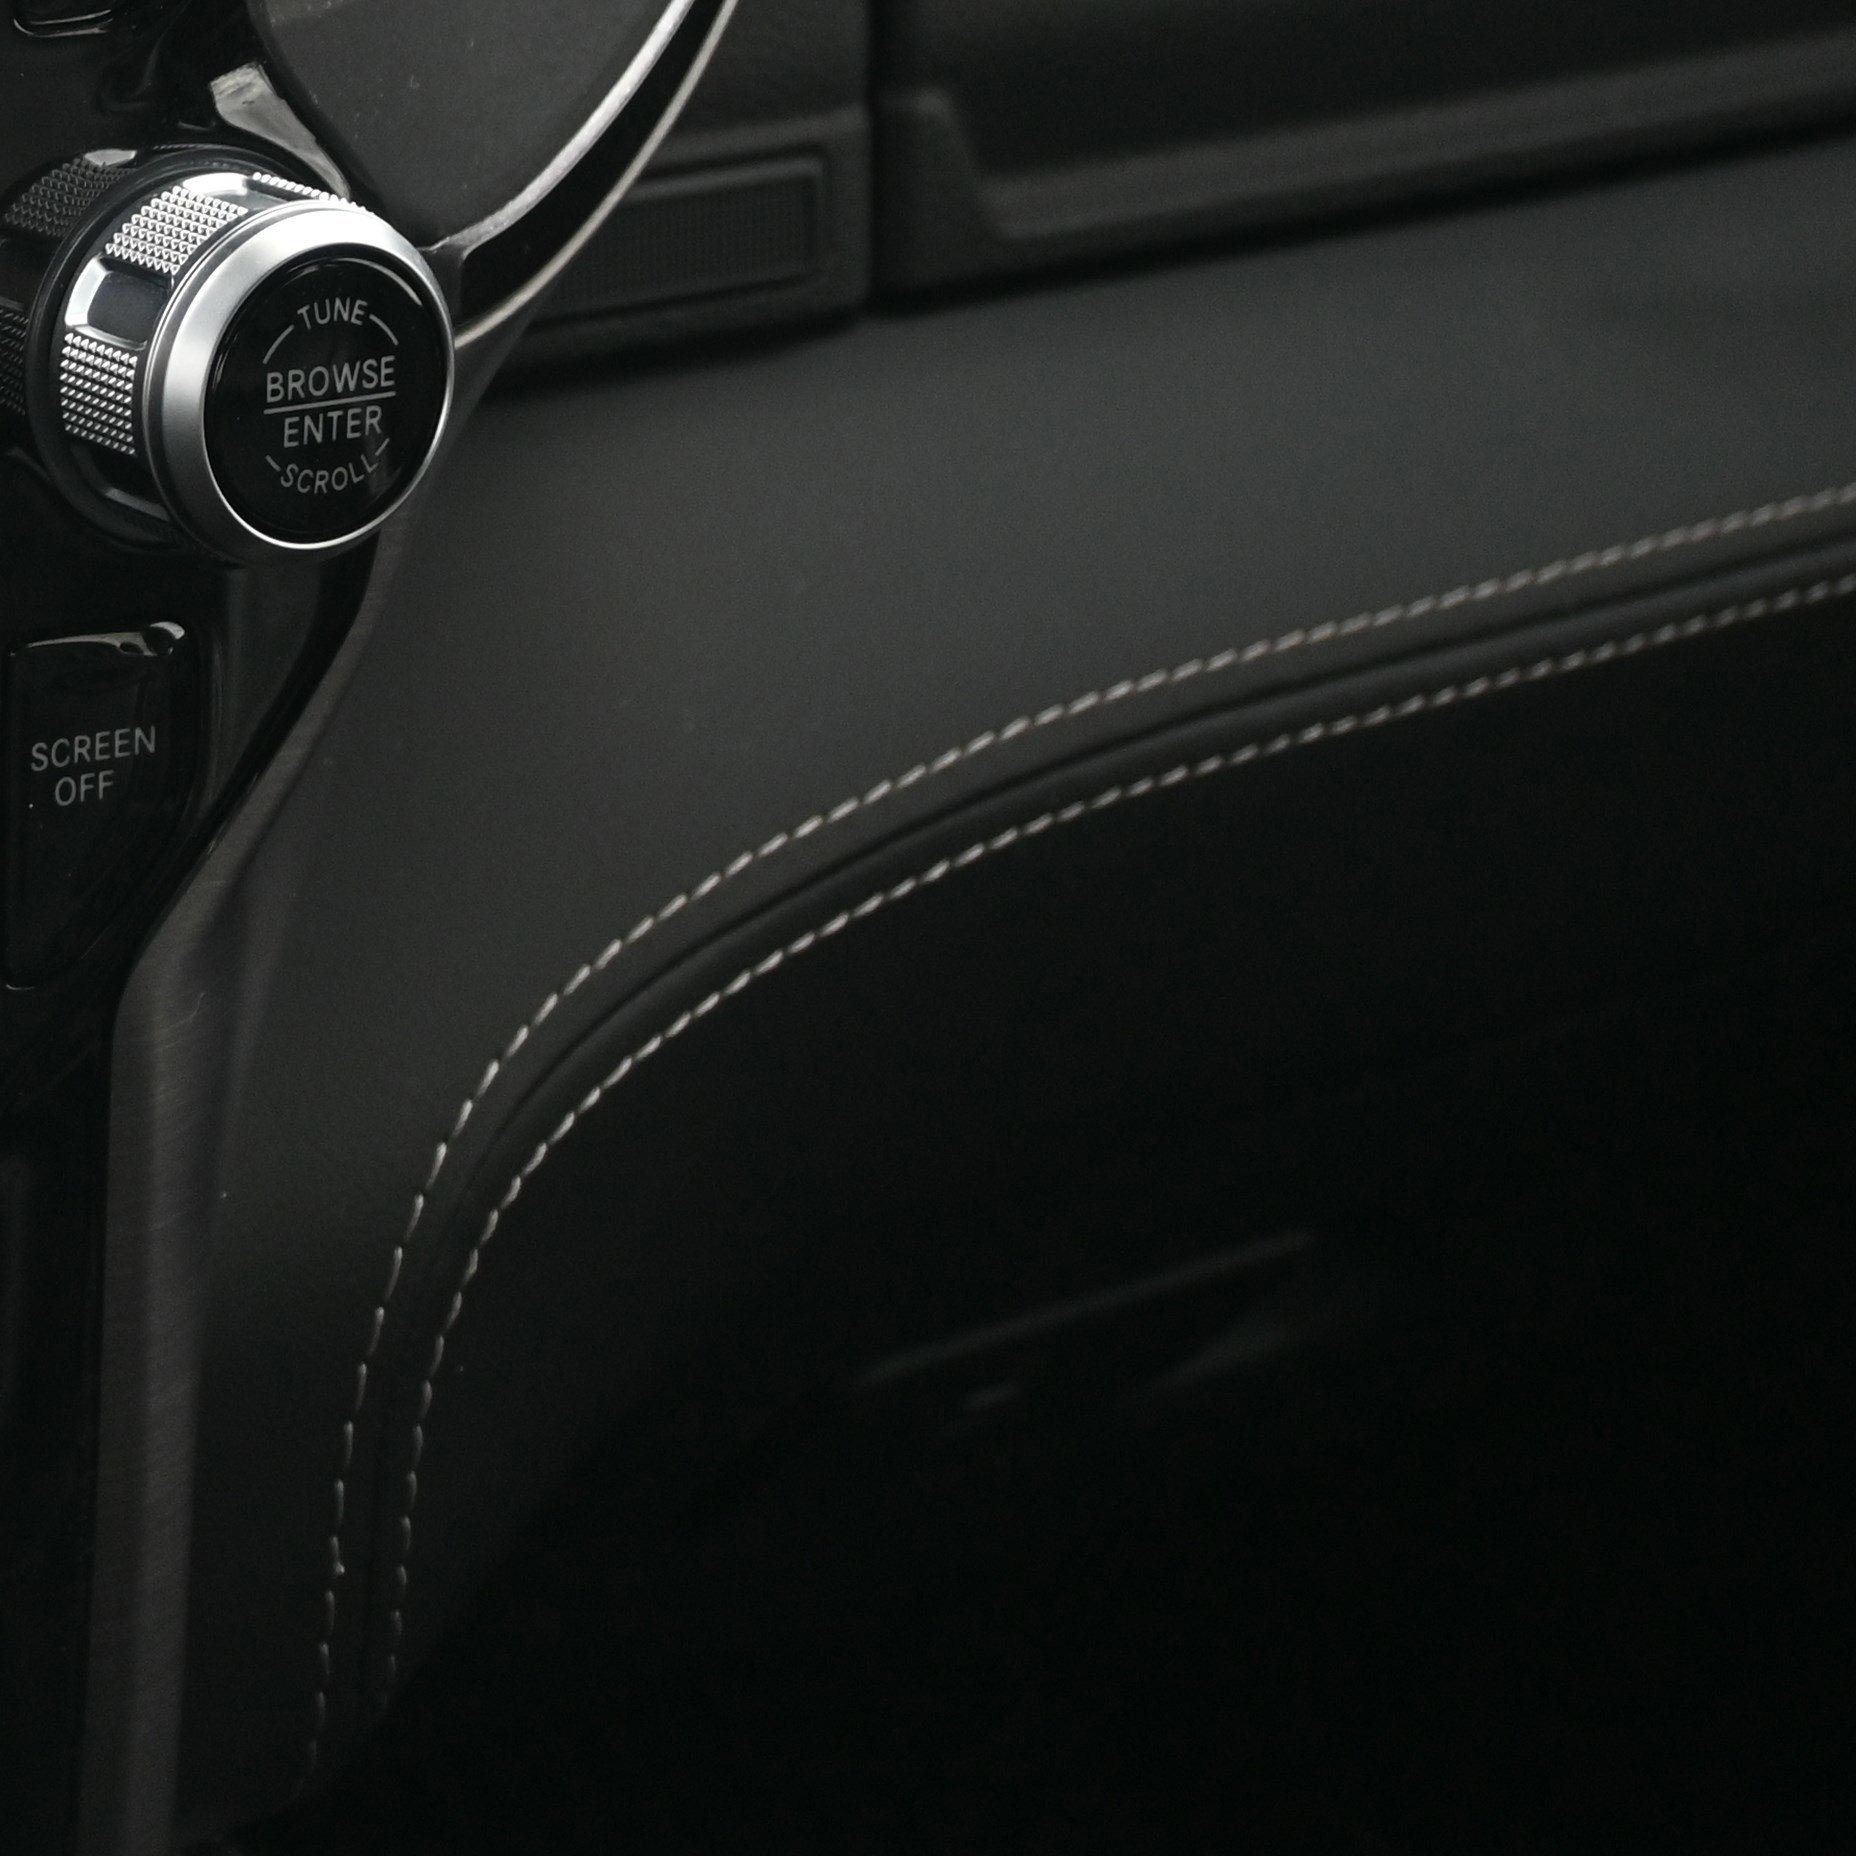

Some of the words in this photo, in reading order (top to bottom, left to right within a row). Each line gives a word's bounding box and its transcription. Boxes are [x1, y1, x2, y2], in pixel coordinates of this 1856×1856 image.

[297, 296, 369, 328] TUNE
[265, 356, 396, 403] BROWSE
[283, 405, 383, 448] ENTER
[280, 452, 379, 495] SCROLL
[30, 725, 157, 773] SCREEN
[54, 769, 115, 807] OFF
